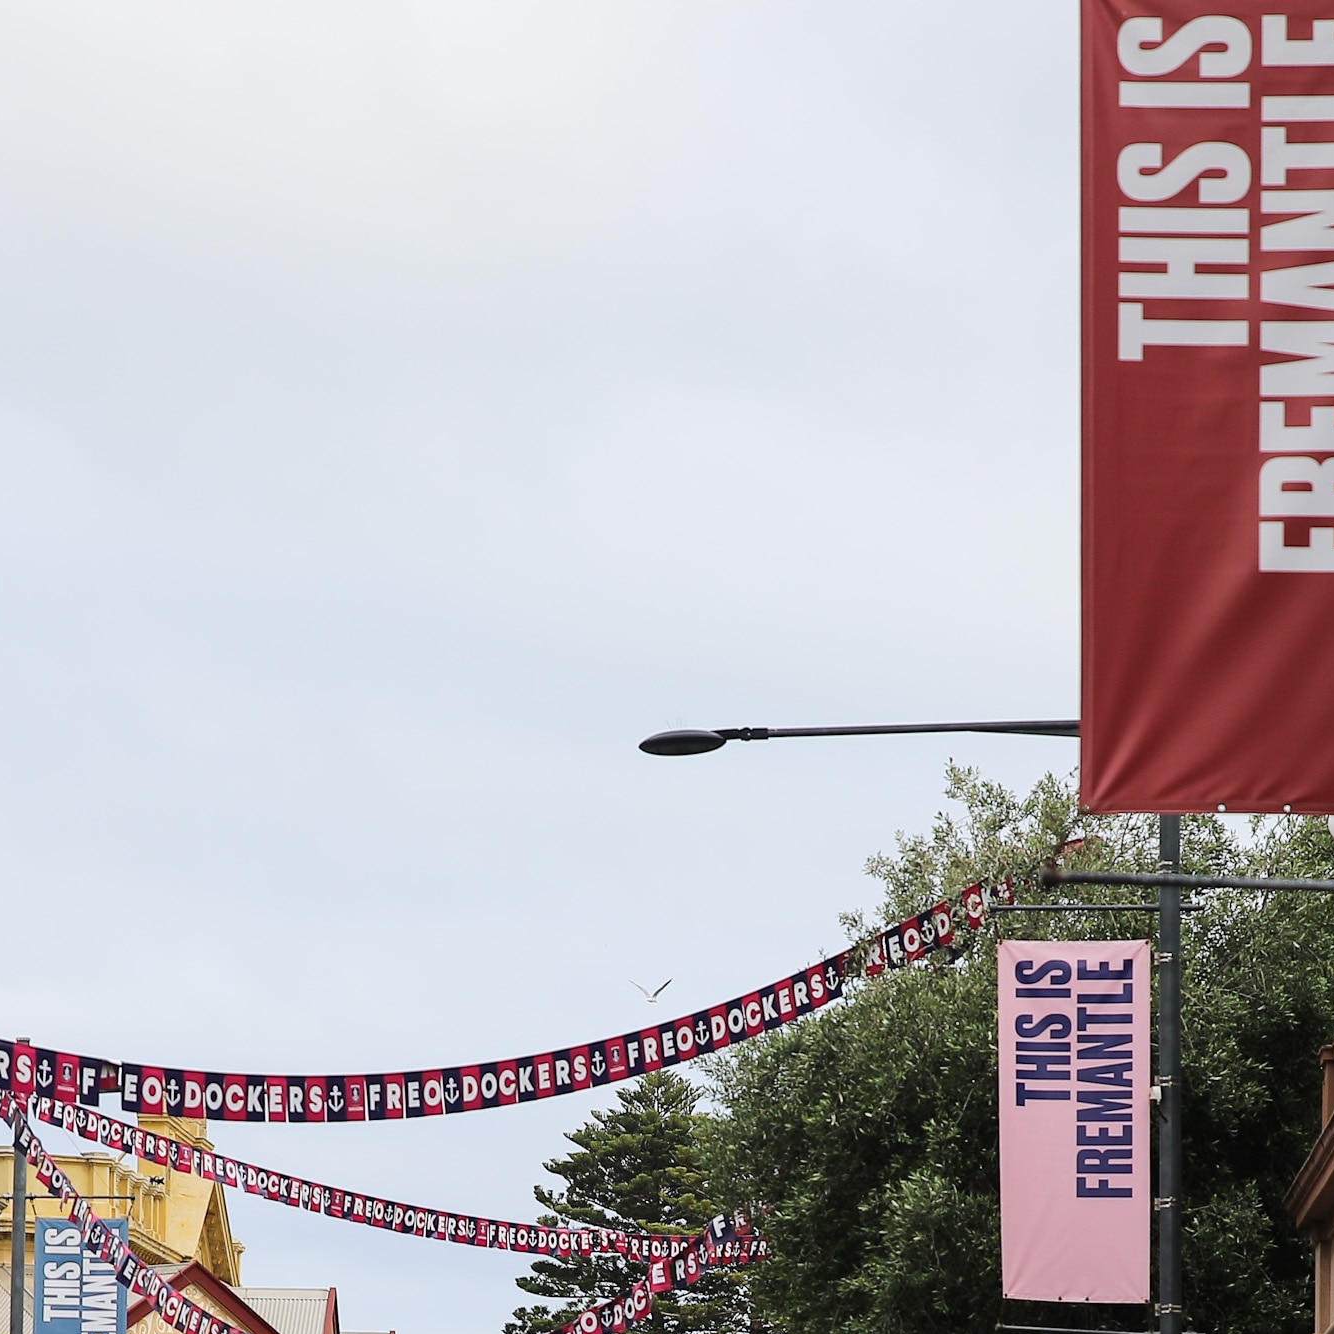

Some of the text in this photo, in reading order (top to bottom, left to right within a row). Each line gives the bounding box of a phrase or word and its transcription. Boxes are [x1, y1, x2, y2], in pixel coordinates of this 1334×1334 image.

[1117, 14, 1252, 362] THIS IS
[184, 1080, 324, 1115] DOCKERS
[369, 1080, 441, 1110] FREO
[462, 1054, 588, 1103] DOCKERS
[627, 1023, 695, 1068] FREO
[711, 971, 827, 1039] DOCKERS
[1015, 959, 1073, 1107] THIS IS
[1076, 958, 1134, 1199] FREMANTLE
[87, 1114, 167, 1158] DOCKERS
[193, 1151, 237, 1179] FREO
[247, 1169, 321, 1205] DOCKERS
[344, 1197, 384, 1222] FREO
[394, 1207, 466, 1238] DOCKERS
[489, 1224, 528, 1245] FREO
[42, 1227, 82, 1323] THIS IS
